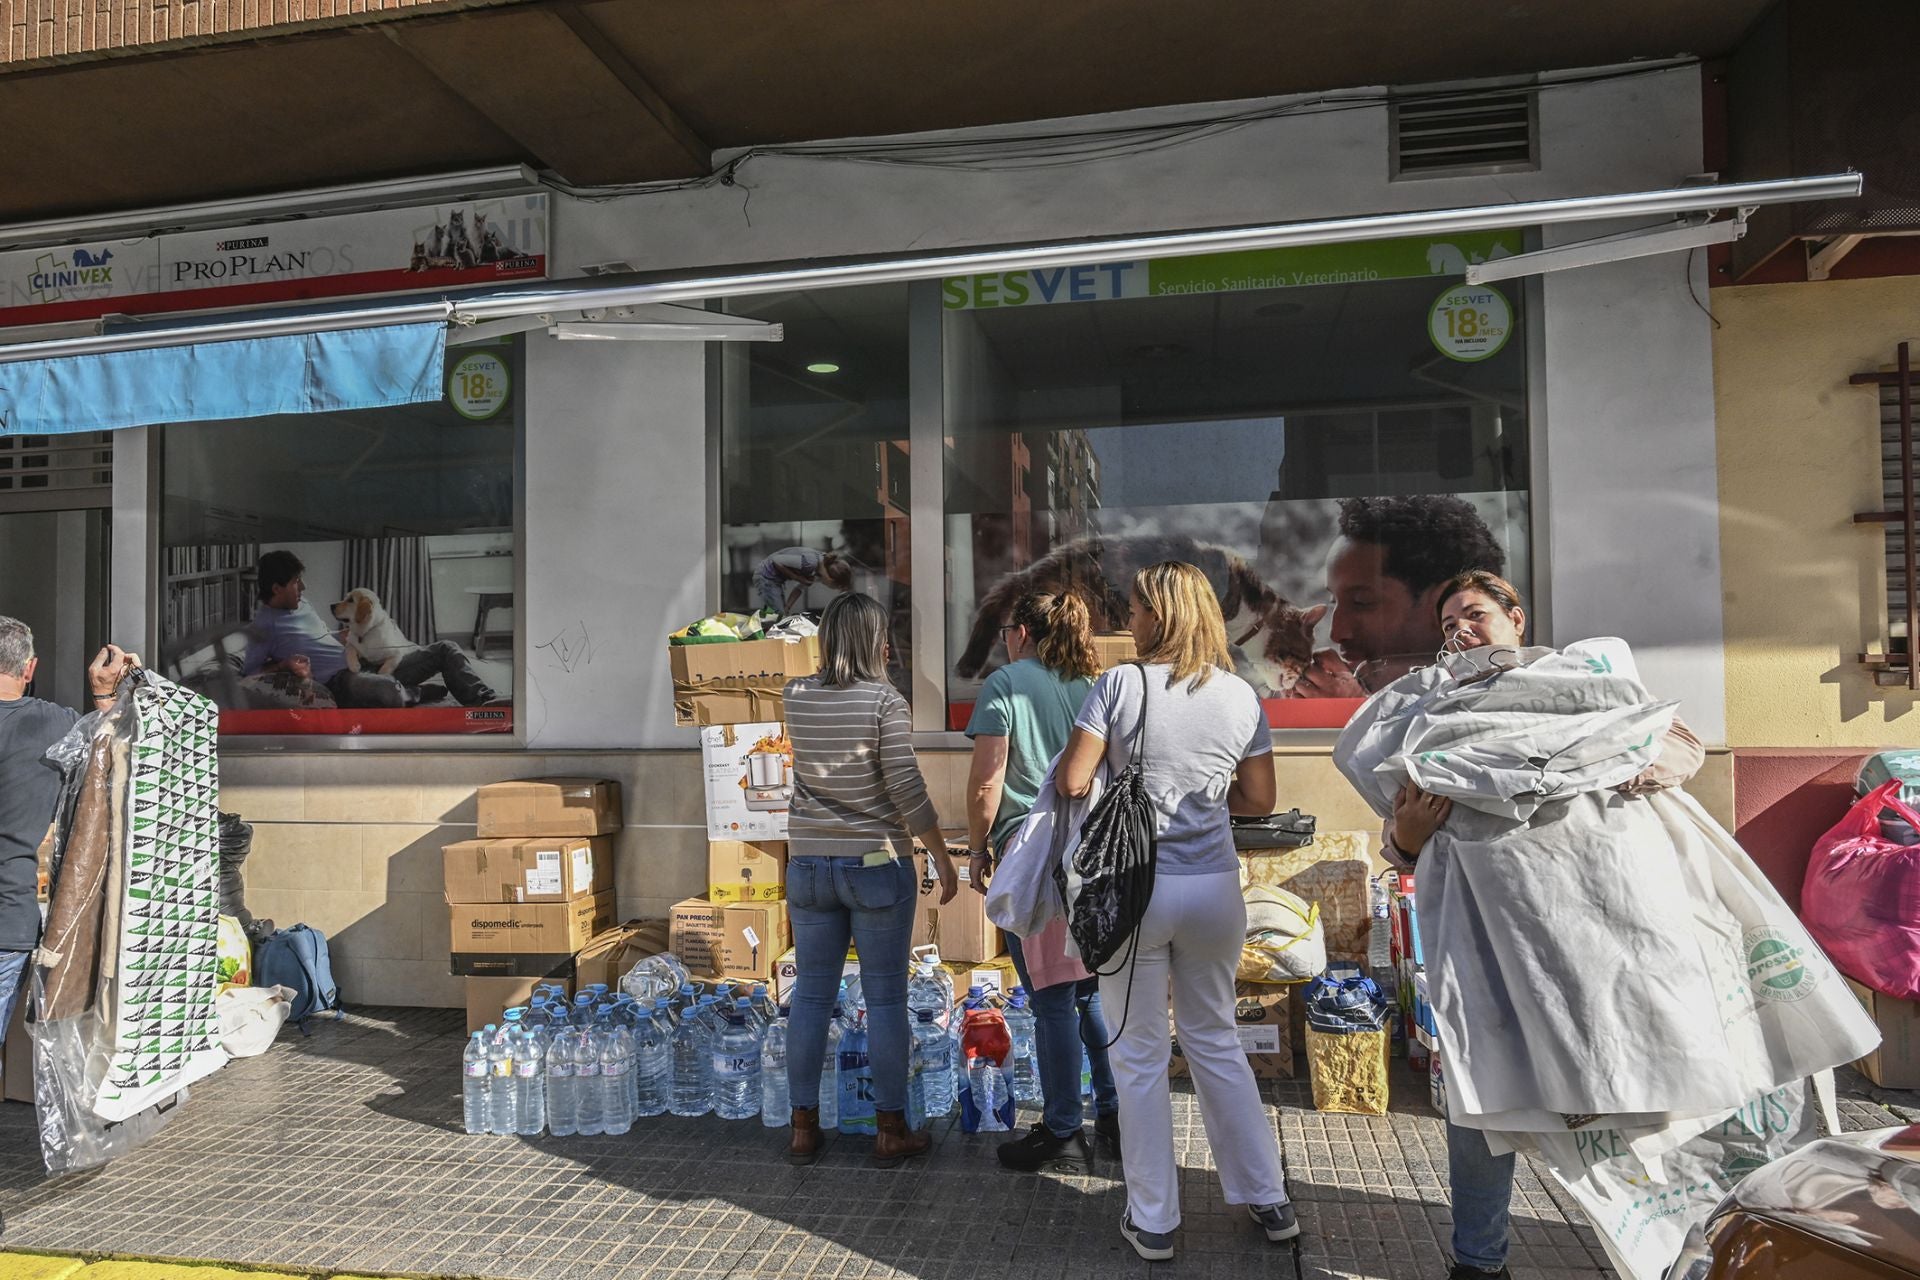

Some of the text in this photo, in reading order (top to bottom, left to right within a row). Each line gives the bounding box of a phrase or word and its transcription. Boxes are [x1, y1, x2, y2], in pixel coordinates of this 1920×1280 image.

[226, 239, 265, 249] PURINA
[505, 260, 536, 269] PURINA
[33, 267, 113, 289] CLINIVEX
[1158, 267, 1378, 296] Servicio Sanitario Veterinario
[944, 262, 1133, 309] SESVET
[1447, 294, 1494, 306] SESVET
[474, 711, 505, 719] PURINA
[471, 919, 520, 930] dispomedic
[1747, 947, 1804, 980] pressto
